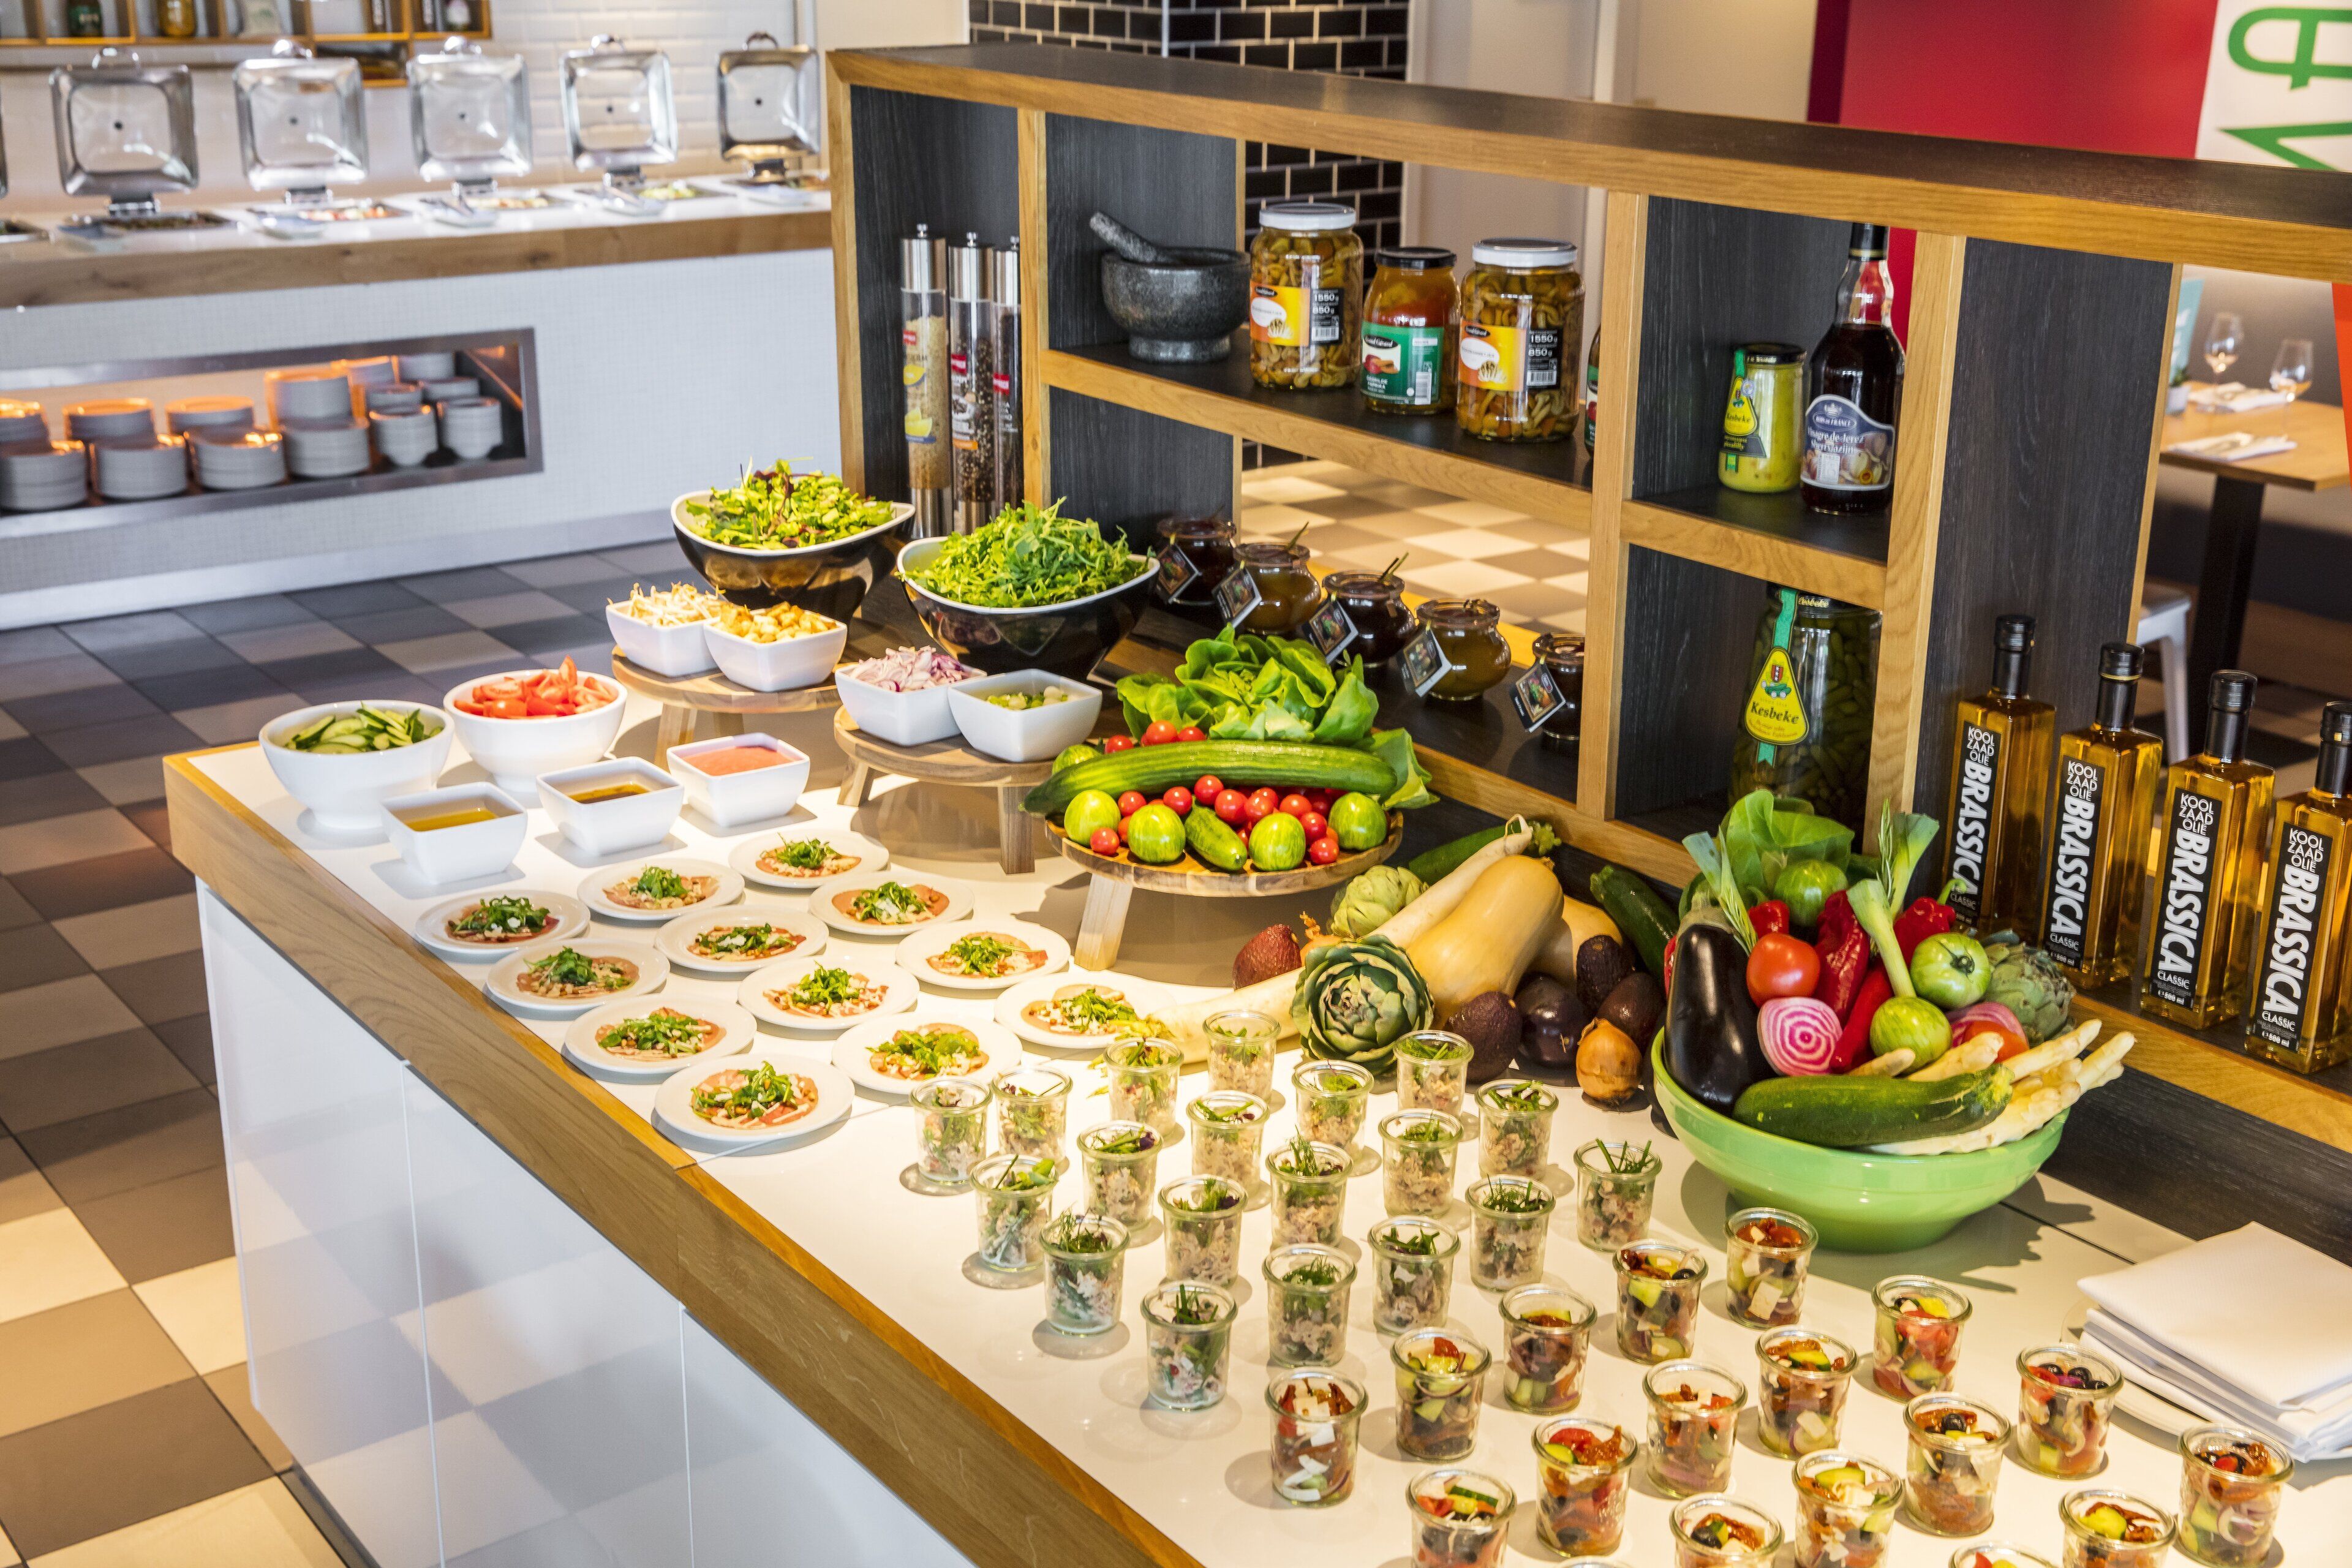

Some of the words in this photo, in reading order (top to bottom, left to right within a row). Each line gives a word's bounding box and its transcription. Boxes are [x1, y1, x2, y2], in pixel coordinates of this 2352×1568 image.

[1830, 431, 1839, 441] de
[1751, 701, 1800, 725] Kesbeke
[1967, 737, 1994, 756] ZAAD
[1968, 726, 1995, 747] KOOL
[1970, 750, 1989, 766] OLIE
[2068, 760, 2098, 781] KOOL
[2067, 772, 2097, 791] ZAAD
[2070, 785, 2092, 802] OLIE
[2180, 793, 2214, 815] KOOL
[2179, 805, 2214, 826] ZAAD
[2182, 818, 2207, 835] OLIE
[2289, 827, 2324, 851] KOOL
[2287, 840, 2323, 862] ZAAD
[2050, 794, 2095, 935] BRASSICA
[2291, 854, 2317, 873] OLIE
[2158, 827, 2210, 973] BRASSICA
[2050, 932, 2079, 951] CLASSIC
[2263, 864, 2320, 1015] BRASSICA
[2157, 970, 2190, 990] CLASSIC
[2164, 992, 2176, 1002] 500
[2176, 997, 2185, 1005] ml
[2261, 1011, 2296, 1031] CLASSIC
[2269, 1033, 2281, 1044] 500
[2282, 1038, 2290, 1048] ml
